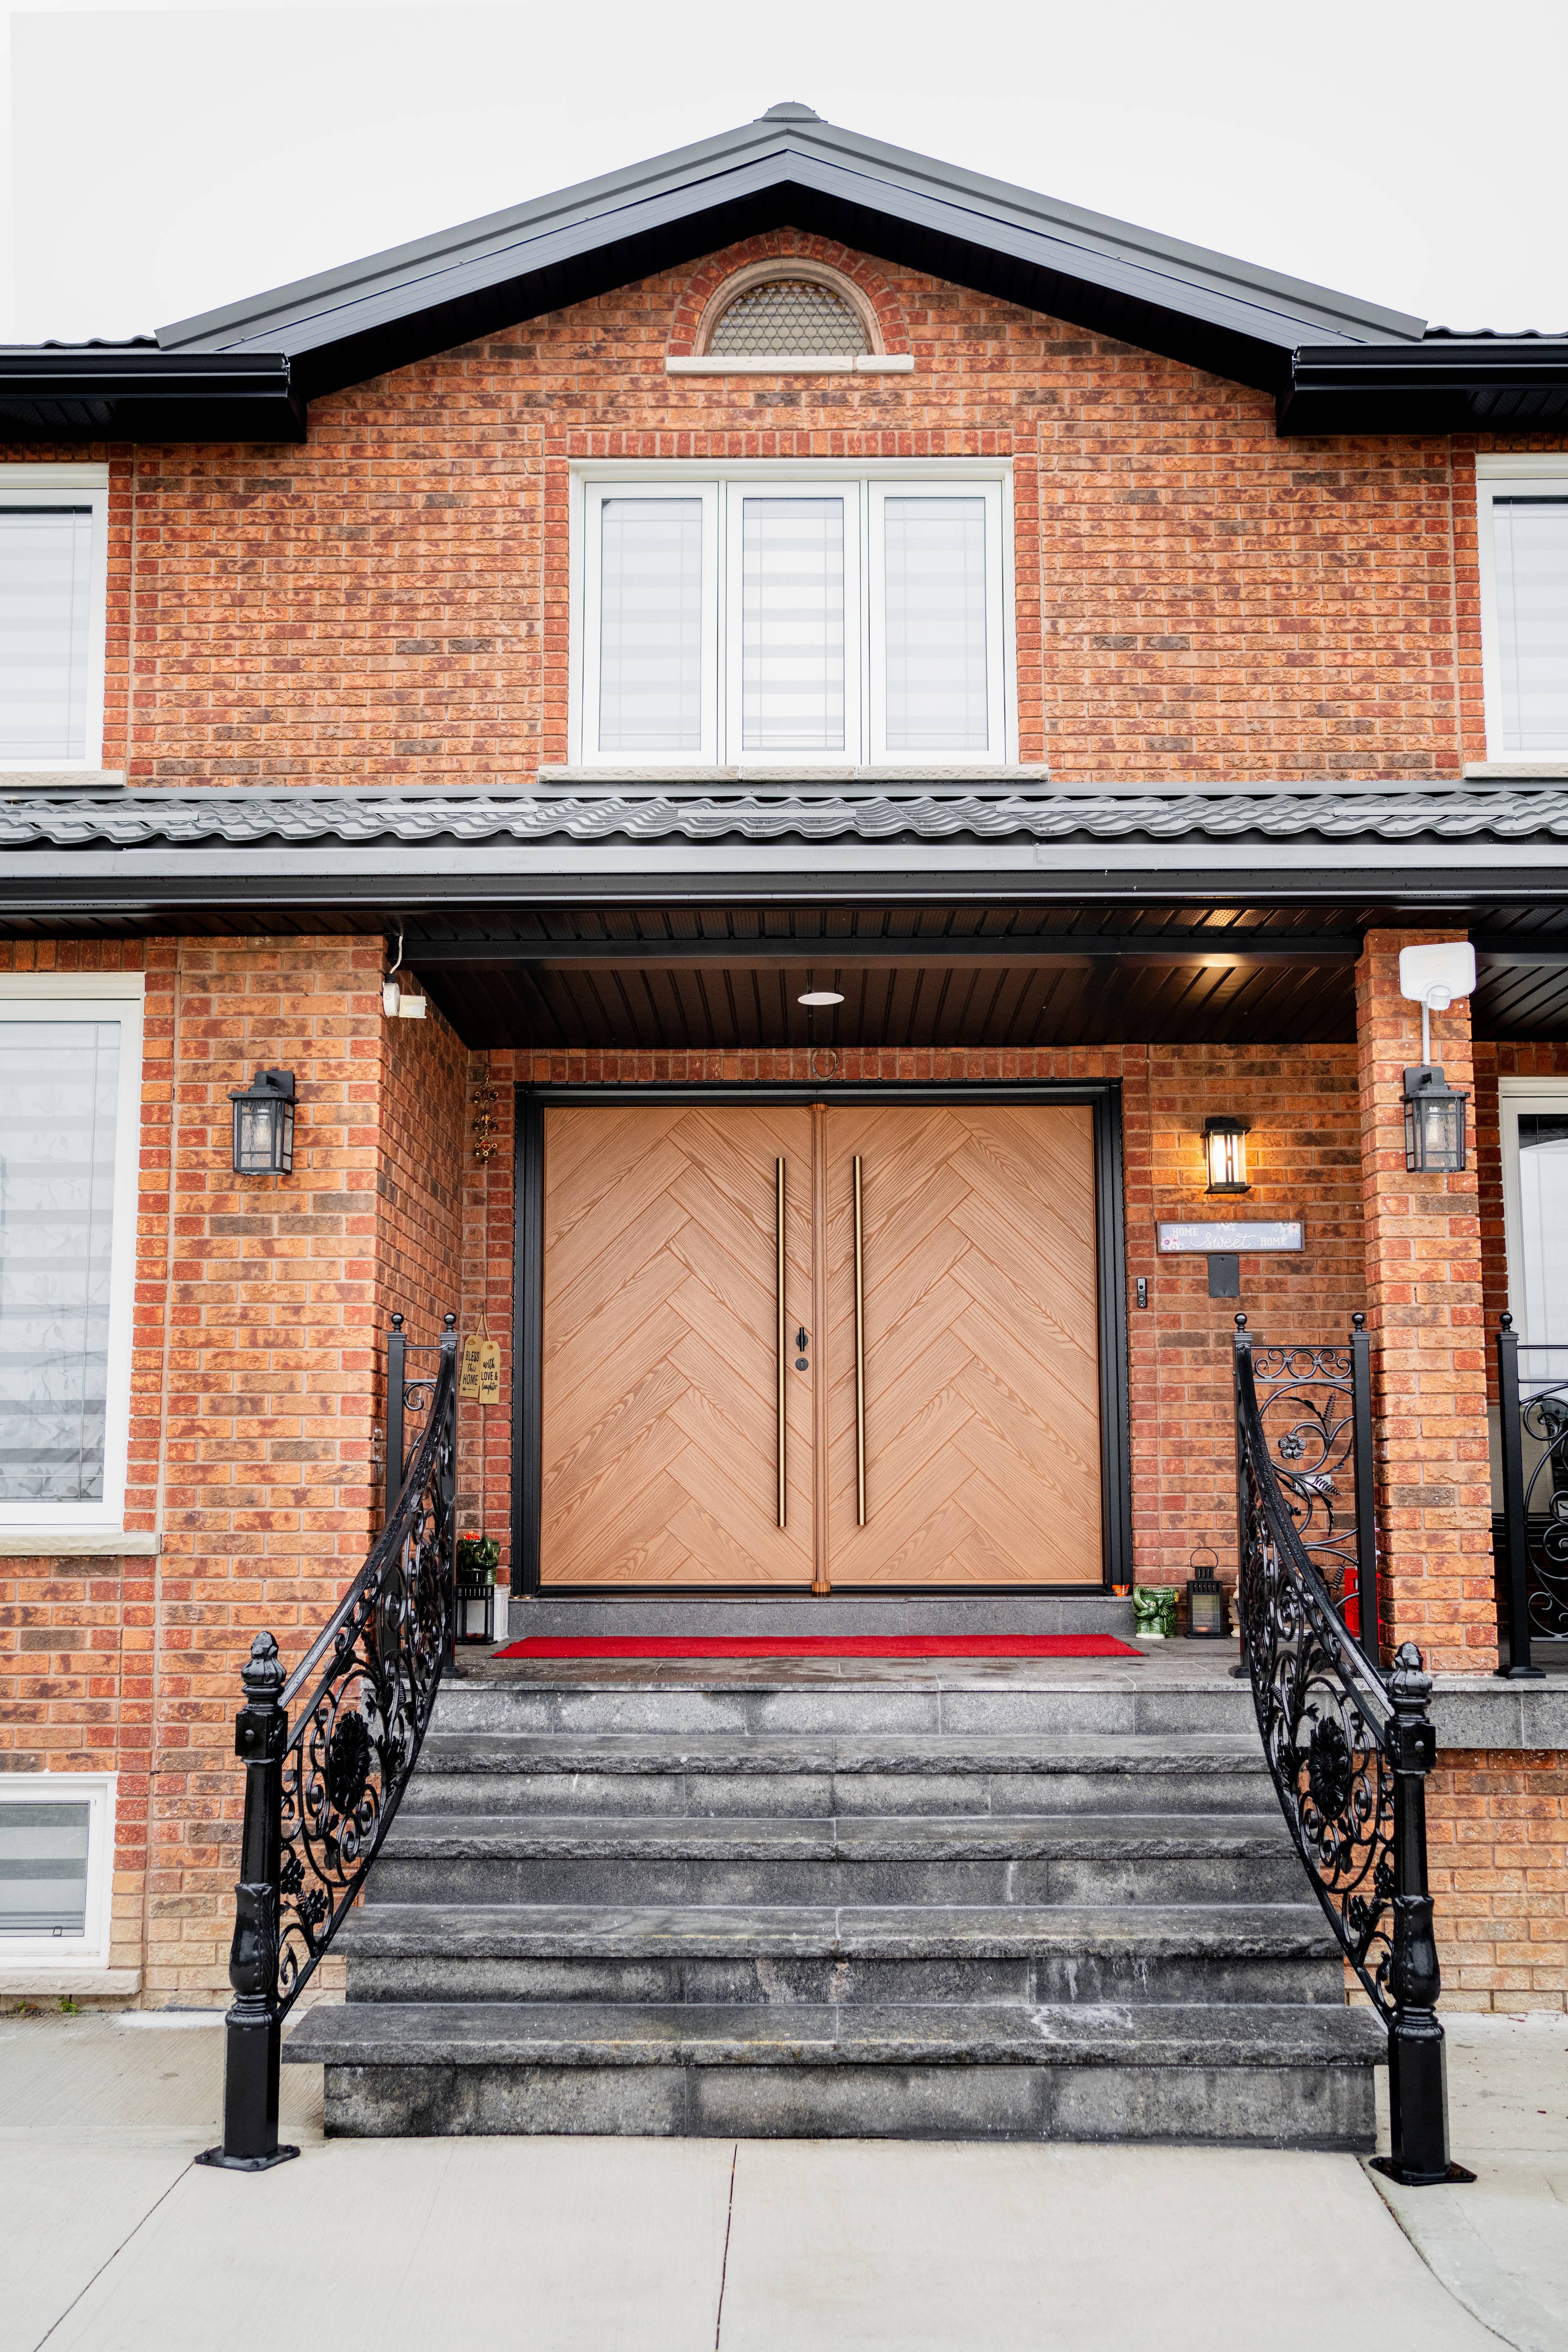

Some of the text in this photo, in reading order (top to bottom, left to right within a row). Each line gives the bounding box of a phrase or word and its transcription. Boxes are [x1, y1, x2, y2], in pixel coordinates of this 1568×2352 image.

[1172, 1227, 1198, 1236] HOME
[1260, 1237, 1286, 1246] HOME
[466, 1351, 479, 1362] BLESS
[467, 1363, 477, 1372] this
[483, 1357, 495, 1370] with
[463, 1374, 478, 1385] HOME
[481, 1371, 498, 1381] LOVE &
[482, 1381, 497, 1394] laughter
